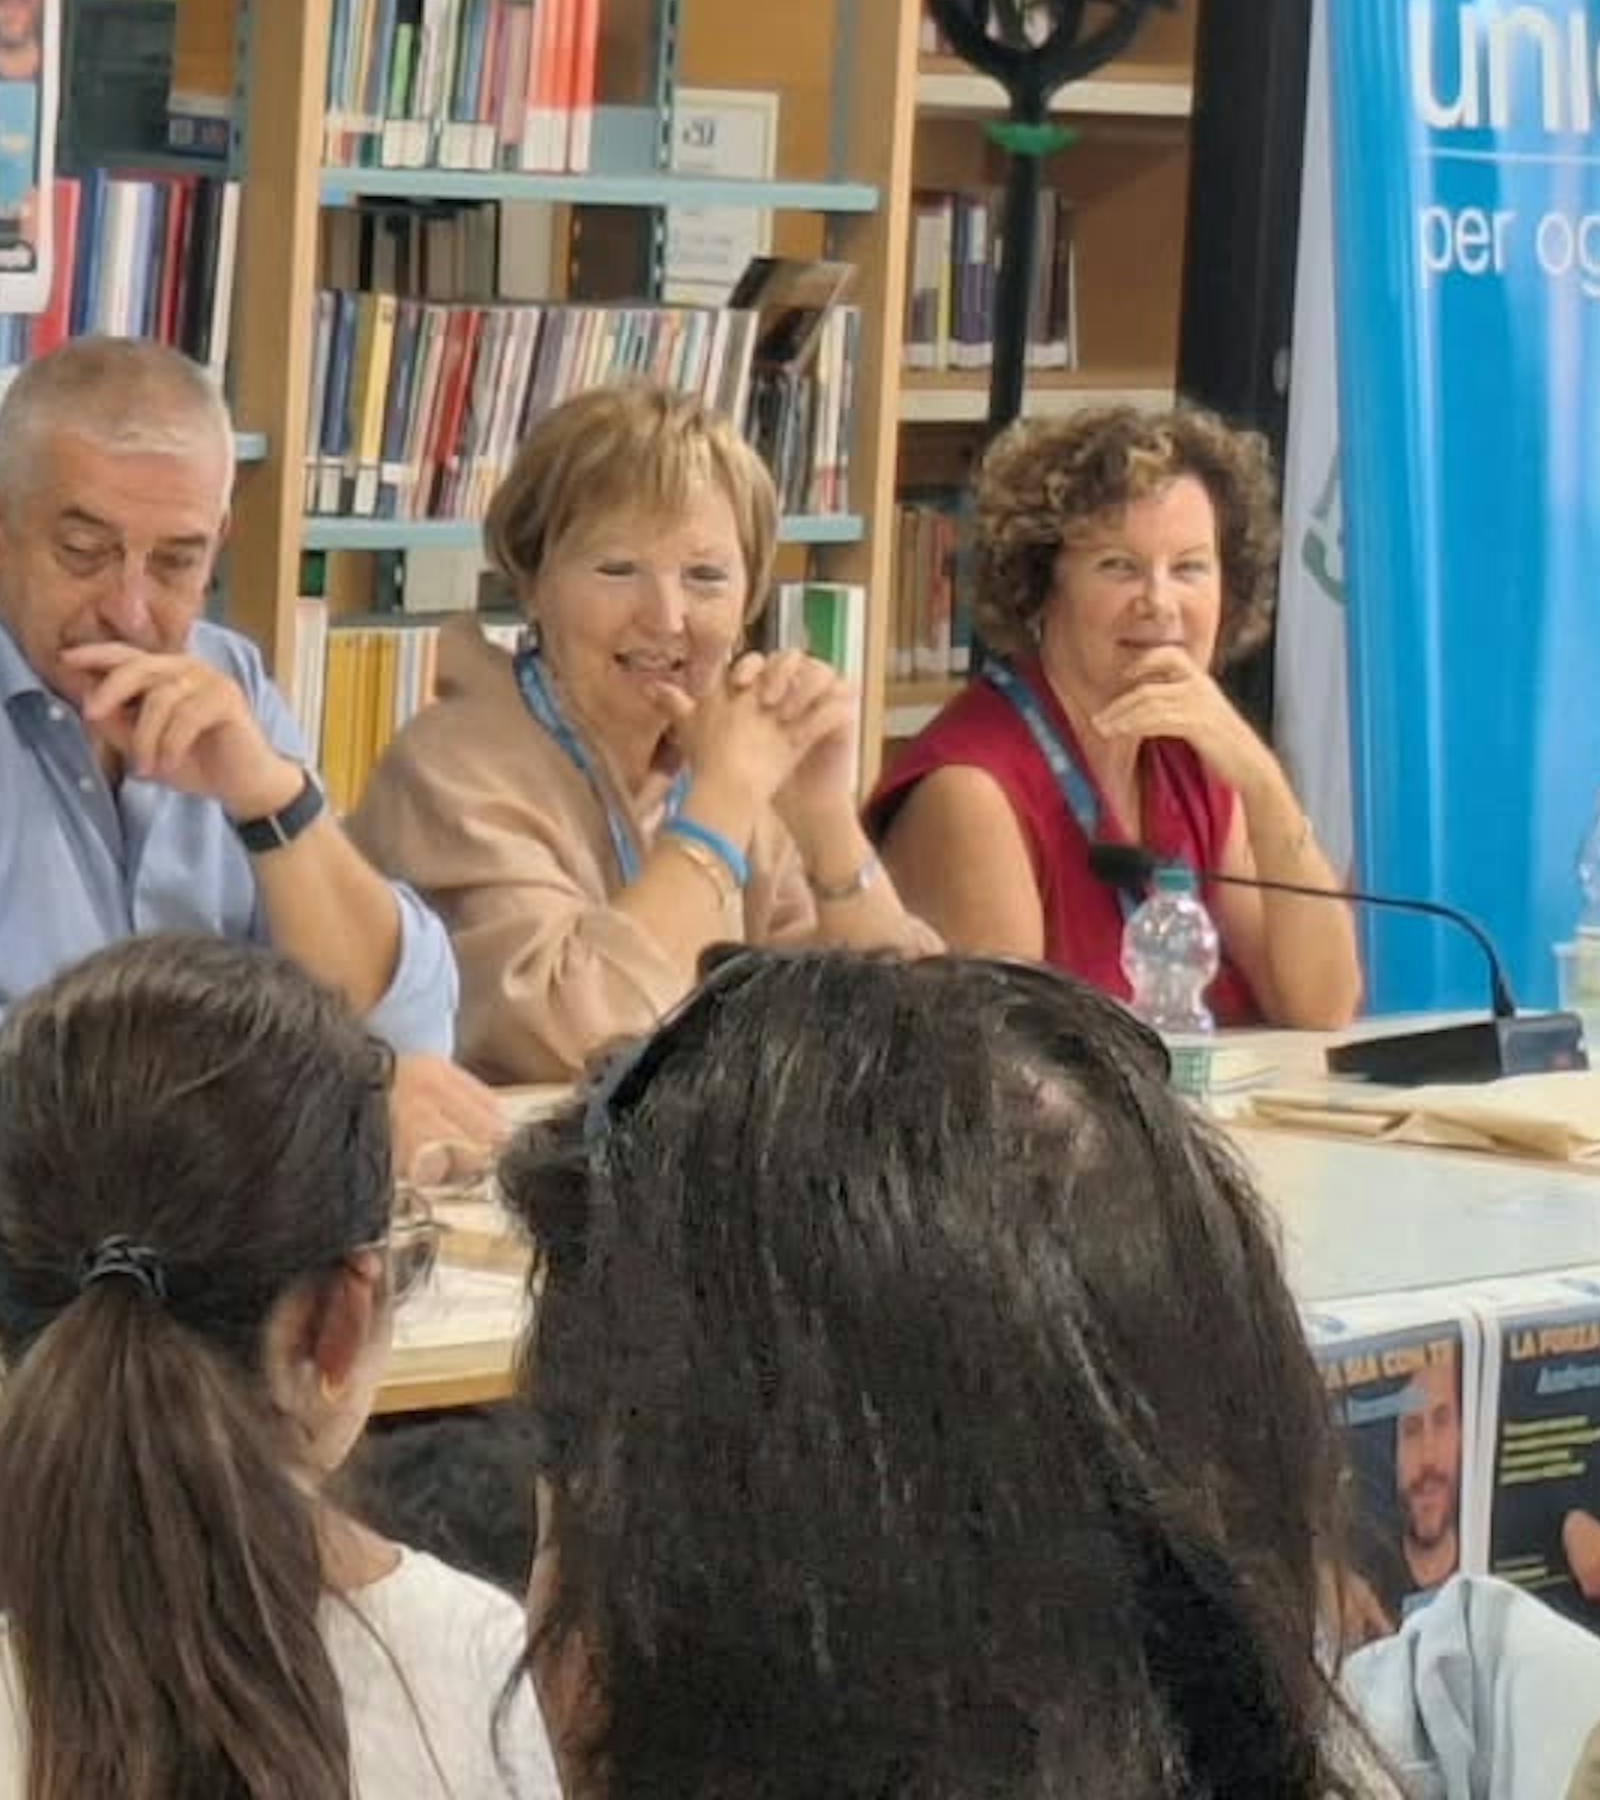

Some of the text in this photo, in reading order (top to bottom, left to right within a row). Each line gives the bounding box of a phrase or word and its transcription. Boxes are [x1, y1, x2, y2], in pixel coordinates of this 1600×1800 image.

[1421, 203, 1515, 290] per
[1509, 1329, 1537, 1361] LA
[1539, 1320, 1600, 1357] FORZA
[1346, 1352, 1377, 1387] SIA
[1383, 1344, 1423, 1380] CON
